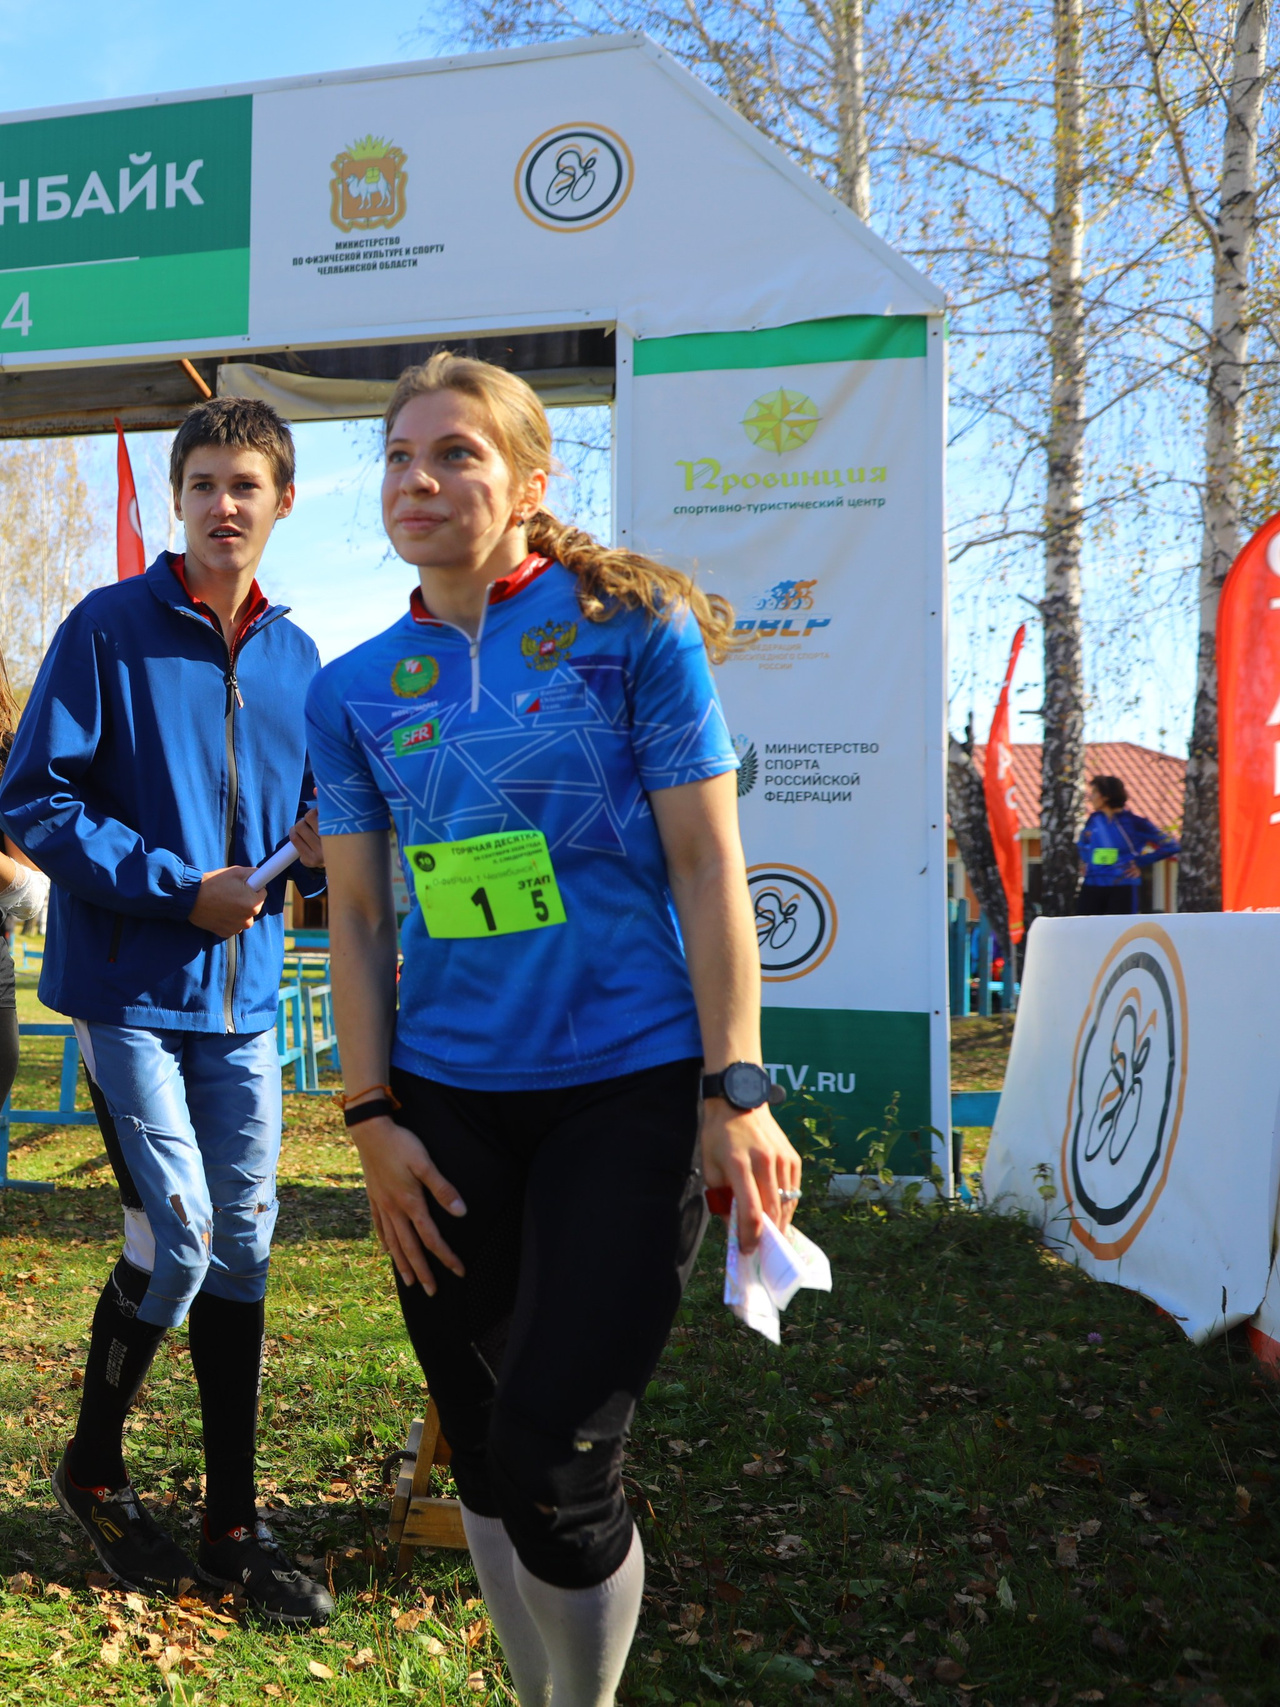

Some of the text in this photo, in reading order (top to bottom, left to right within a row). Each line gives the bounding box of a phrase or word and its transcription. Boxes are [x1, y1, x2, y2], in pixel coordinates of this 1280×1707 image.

[335, 236, 400, 250] МИНИСТЕРСТВО
[292, 244, 445, 266] ПО ФИЗИЧЕСКОЙ КУЛЬТУРЕ И СПОРТУ
[317, 258, 418, 275] ЧЕЛЯБИНСКОЙ ОБЛАСТИ
[675, 457, 887, 496] Провинция
[673, 496, 886, 516] спортивно-туристический центр
[724, 652, 830, 661] ЕЛОСИПЕДНОГО СПОРТА
[402, 726, 429, 745] SFR
[765, 743, 879, 754] МИНИСТЕРСТВО
[764, 759, 820, 770] СПОРТА
[765, 772, 861, 786] РОССИЙСКОЙ
[764, 791, 852, 804] ФЕДЕРАЦИИ
[451, 832, 539, 855] ГОРЯЧАЯ ДЕСЯТКА
[517, 874, 551, 890] ЭТАП
[471, 887, 497, 932] 1
[531, 889, 550, 922] 5
